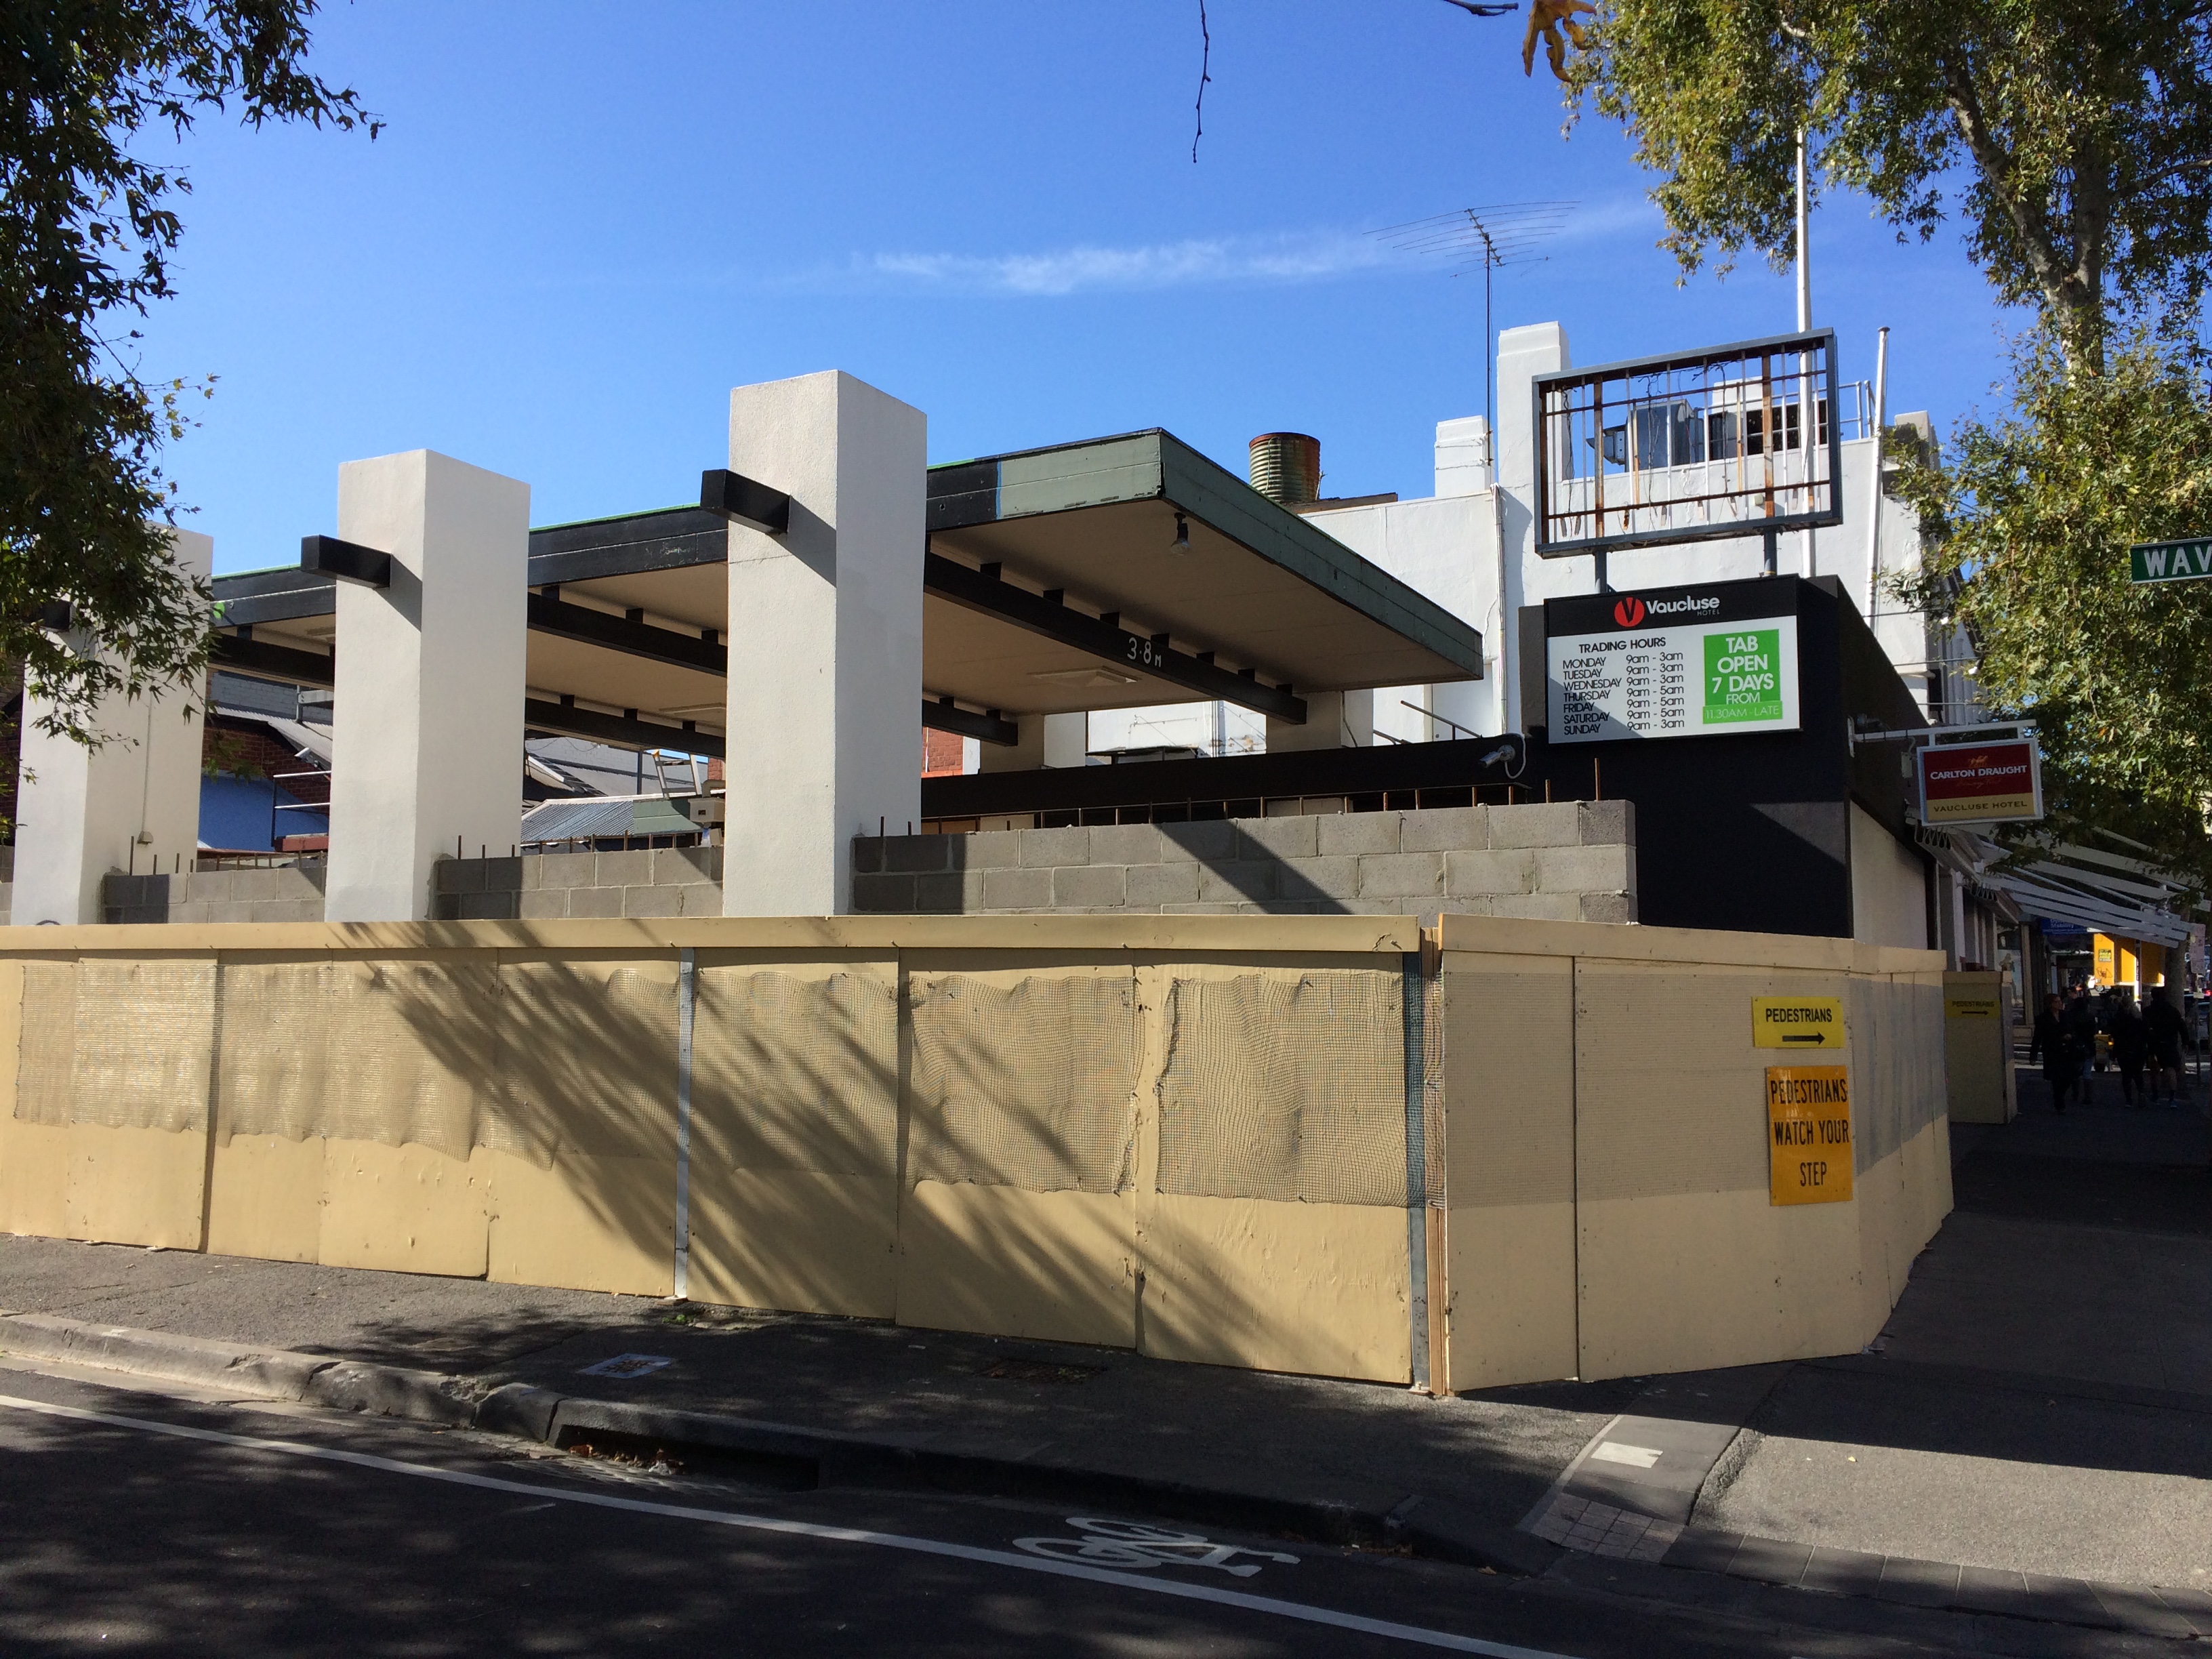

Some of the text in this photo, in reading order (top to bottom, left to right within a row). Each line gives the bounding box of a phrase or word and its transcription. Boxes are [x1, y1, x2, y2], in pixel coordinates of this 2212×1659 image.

[2144, 544, 2212, 577] WAV
[1646, 595, 1720, 614] Vaucluse
[1579, 637, 1666, 653] TRADING HOURS
[1725, 635, 1759, 653] TAB
[1563, 657, 1607, 670] MONDAY
[1626, 655, 1650, 664] 9am
[1660, 652, 1683, 661] 3am
[1717, 654, 1768, 674] OPEN
[1563, 668, 1603, 680] TUESDAY
[1626, 665, 1650, 676] 9am
[1660, 663, 1683, 672] 3am
[1563, 678, 1622, 691] WEDNESDAY
[1626, 677, 1650, 687] 9am
[1660, 674, 1684, 684] 3am
[1712, 673, 1774, 694] 7 DAYS
[1563, 690, 1611, 702] THURSDAY
[1626, 688, 1650, 697] 9am
[1660, 685, 1684, 695] 5am
[1726, 692, 1761, 705] FROM
[1563, 702, 1595, 713] FRIDAY
[1626, 699, 1650, 709] 9am
[1660, 697, 1685, 706] 5am
[1706, 708, 1747, 719] 11.30AM
[1755, 705, 1780, 716] LATE
[1563, 712, 1610, 724] SATURDAY
[1627, 710, 1650, 720] 9am
[1660, 708, 1685, 717] 5am
[1564, 724, 1601, 735] SUNDAY
[1627, 721, 1650, 731] 9am
[1661, 719, 1685, 729] 3am
[1930, 765, 2027, 779] CARLTON DRAUGHT
[1933, 800, 2028, 812] VAUCLUSE HOTEL
[1765, 1008, 1832, 1023] PEDESTRIANS
[1770, 1078, 1848, 1104] PEDESTRIANS
[1774, 1119, 1849, 1146] WATCH YOUR
[1800, 1162, 1827, 1187] STEP
